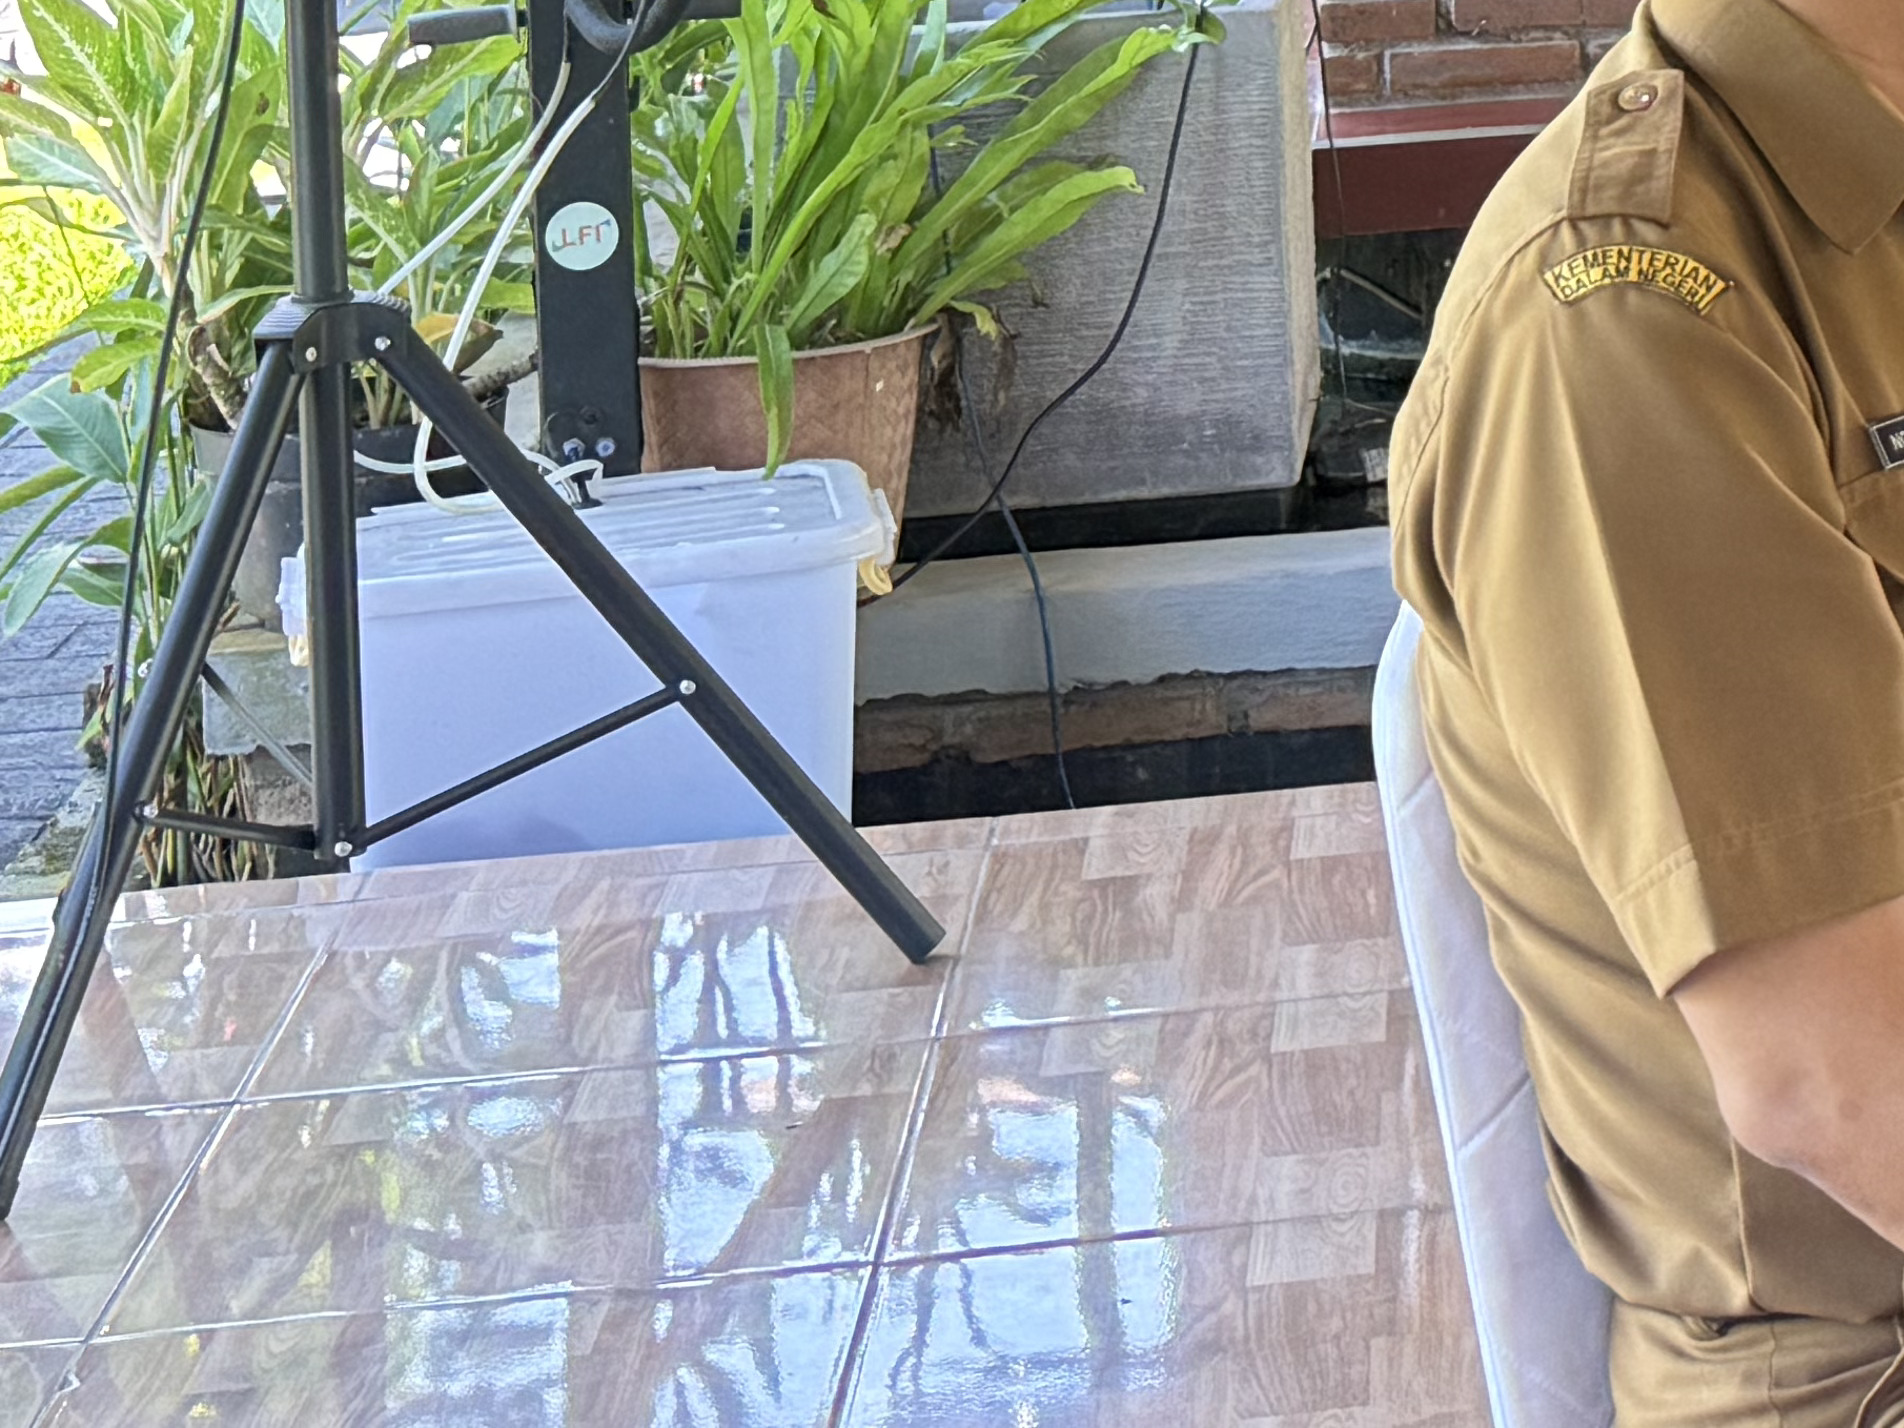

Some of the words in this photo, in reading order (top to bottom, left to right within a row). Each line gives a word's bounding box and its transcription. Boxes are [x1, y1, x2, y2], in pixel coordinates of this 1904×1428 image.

[1551, 247, 1718, 293] KEMENTERIAN
[1561, 266, 1631, 299] DALAM
[1637, 266, 1706, 304] NEGERI
